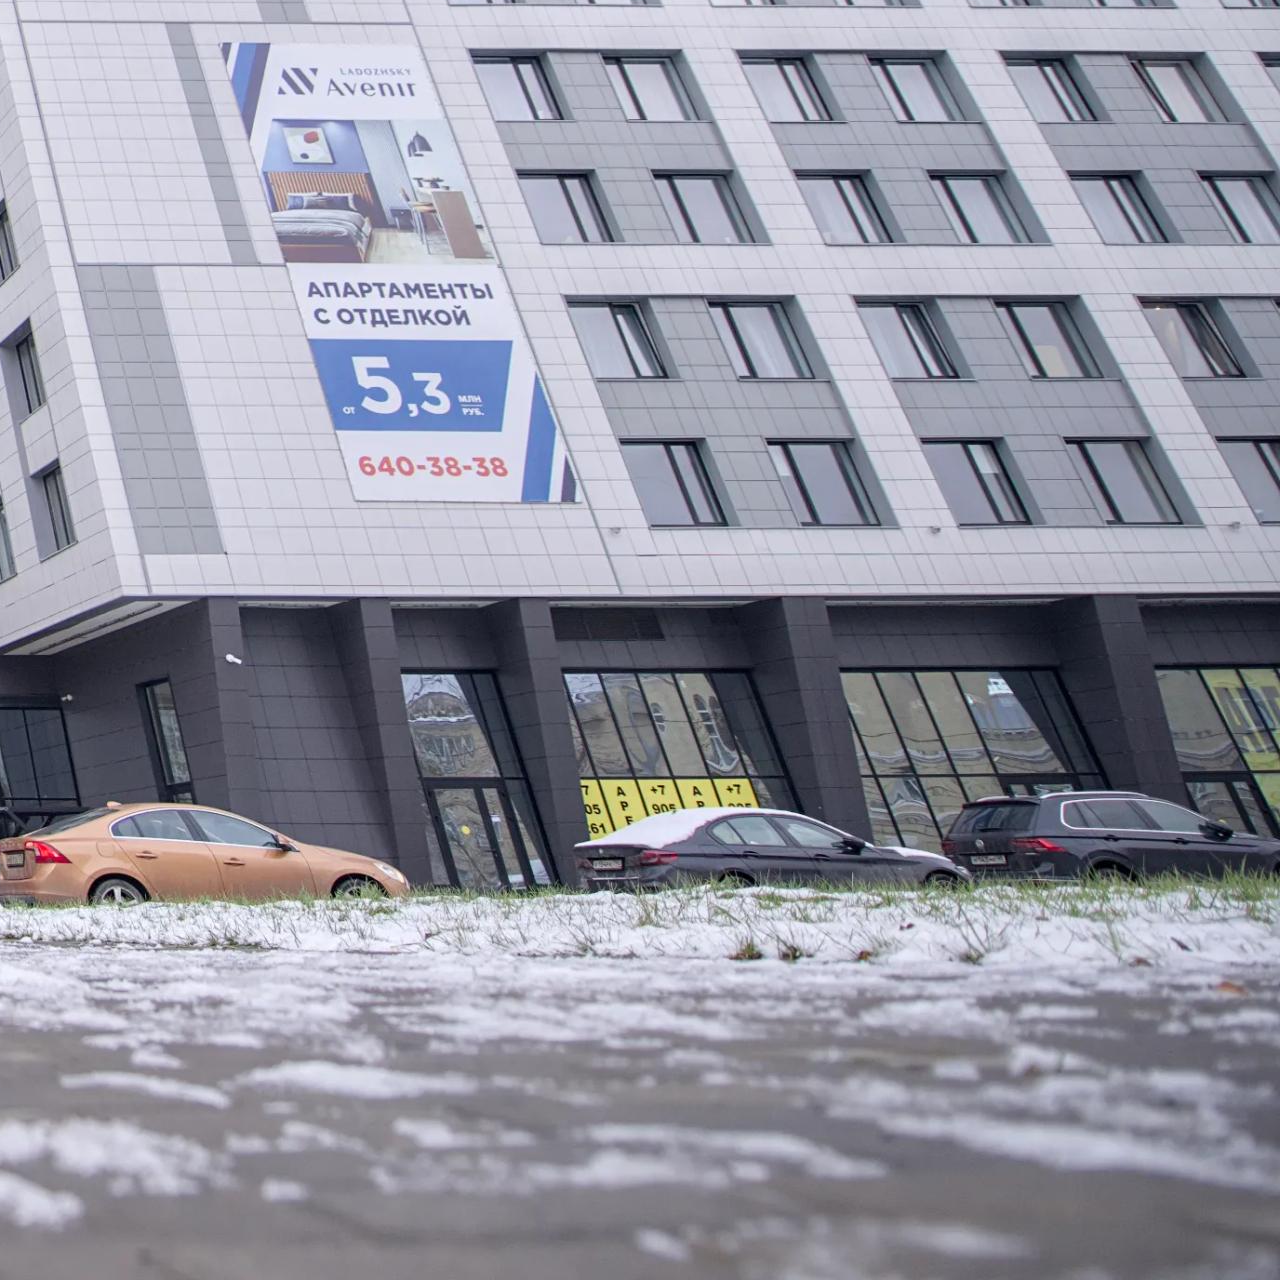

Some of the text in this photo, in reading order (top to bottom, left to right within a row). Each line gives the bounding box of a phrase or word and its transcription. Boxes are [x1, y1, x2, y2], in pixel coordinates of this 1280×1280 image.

[340, 67, 411, 76] LADOZHSKY
[308, 282, 494, 299] АПАРТАМЕНТЫ
[314, 305, 471, 328] С ОТДЕЛКОЙ
[351, 356, 451, 418] 5,3
[358, 455, 509, 478] 640-38-38
[651, 784, 666, 796] +7
[726, 783, 742, 795] +7
[585, 803, 602, 815] 05
